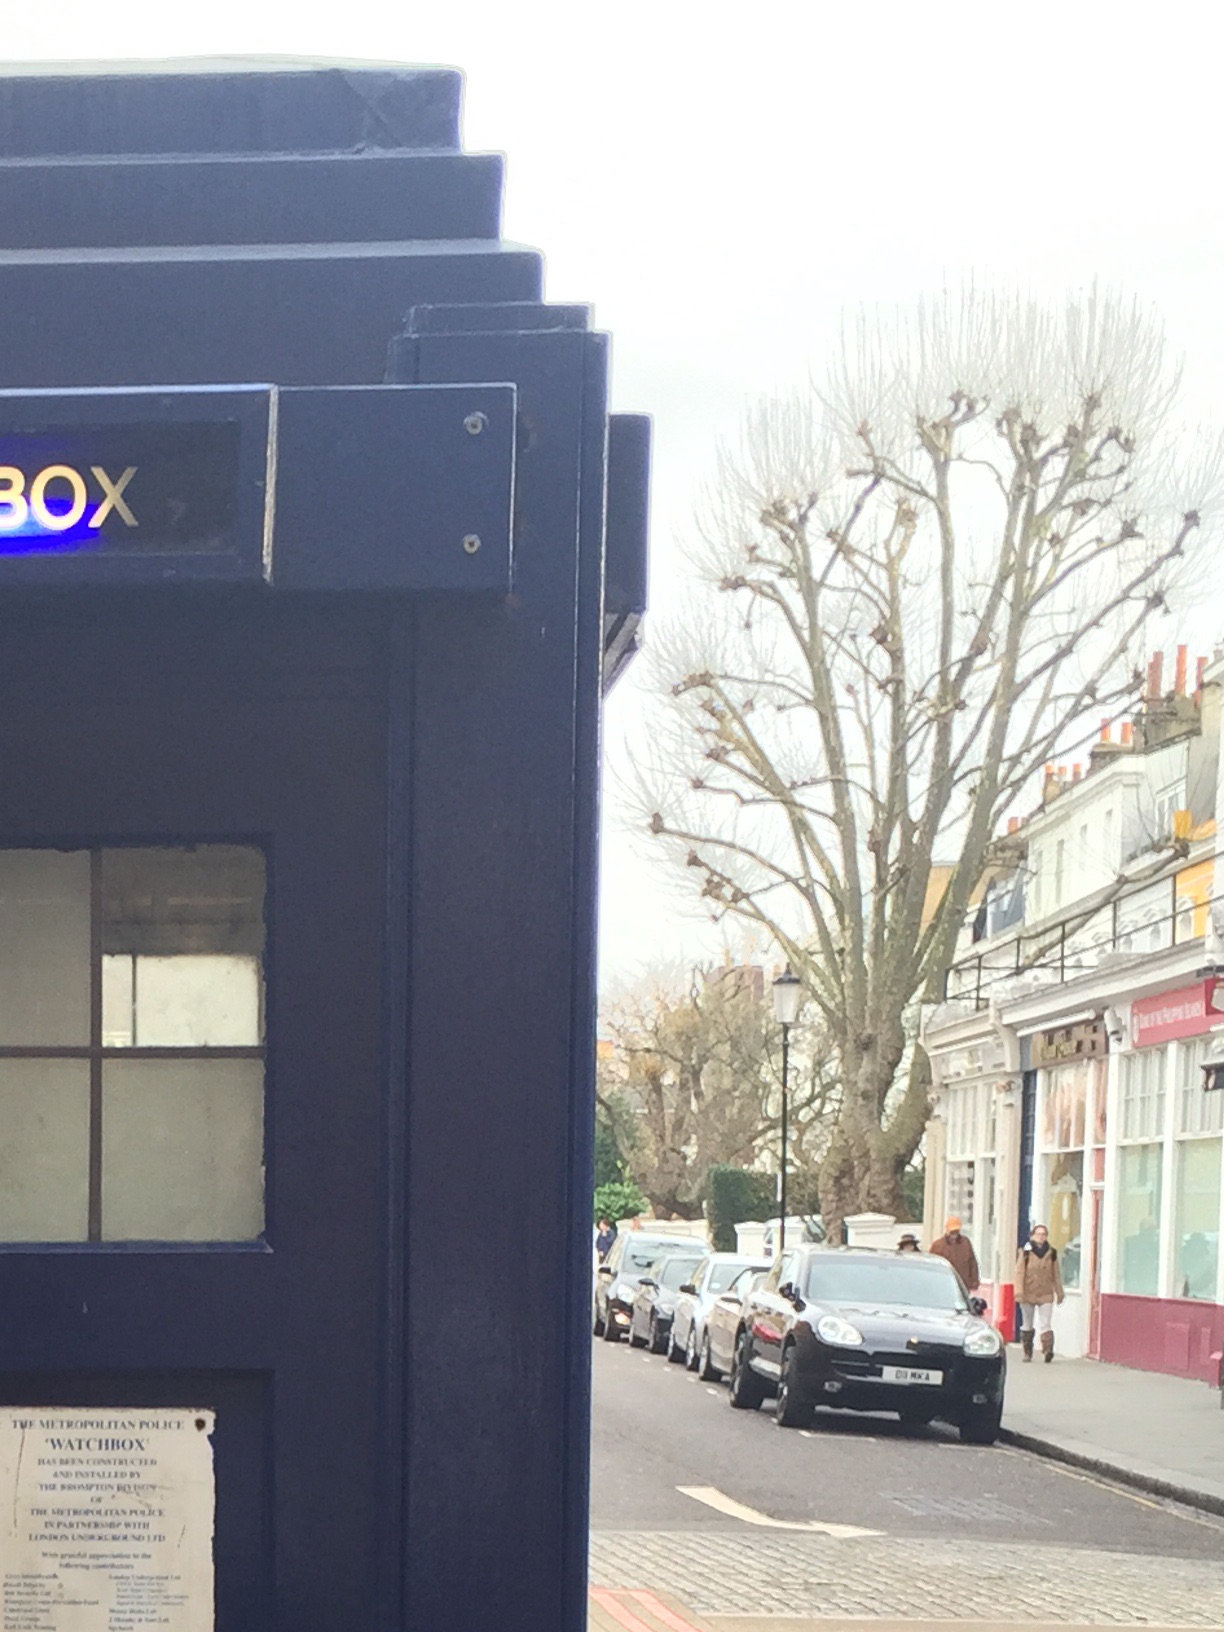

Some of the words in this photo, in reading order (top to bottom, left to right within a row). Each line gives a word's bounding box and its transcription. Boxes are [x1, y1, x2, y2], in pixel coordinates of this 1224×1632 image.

[12, 1419, 34, 1430] THE
[39, 1419, 136, 1430] METROPOLITAN
[139, 1419, 185, 1430] POLICE
[37, 1457, 57, 1467] HAS
[59, 1457, 84, 1467] BEEN
[86, 1457, 158, 1467] CONSTRUCTED
[53, 1470, 73, 1479] AND
[75, 1470, 127, 1479] INSTALLED
[129, 1470, 141, 1479] BY
[39, 1483, 57, 1492] THE
[60, 1483, 114, 1492] BROMPTON
[30, 1507, 48, 1517] THE
[51, 1507, 127, 1517] METROPOLITAN
[129, 1507, 165, 1517] POLICE
[44, 1521, 54, 1530] IN
[56, 1521, 122, 1530] PARTNERSHIP
[124, 1521, 150, 1530] WITH
[28, 1533, 69, 1543] LONDON
[71, 1533, 145, 1543] UNDERGROUND
